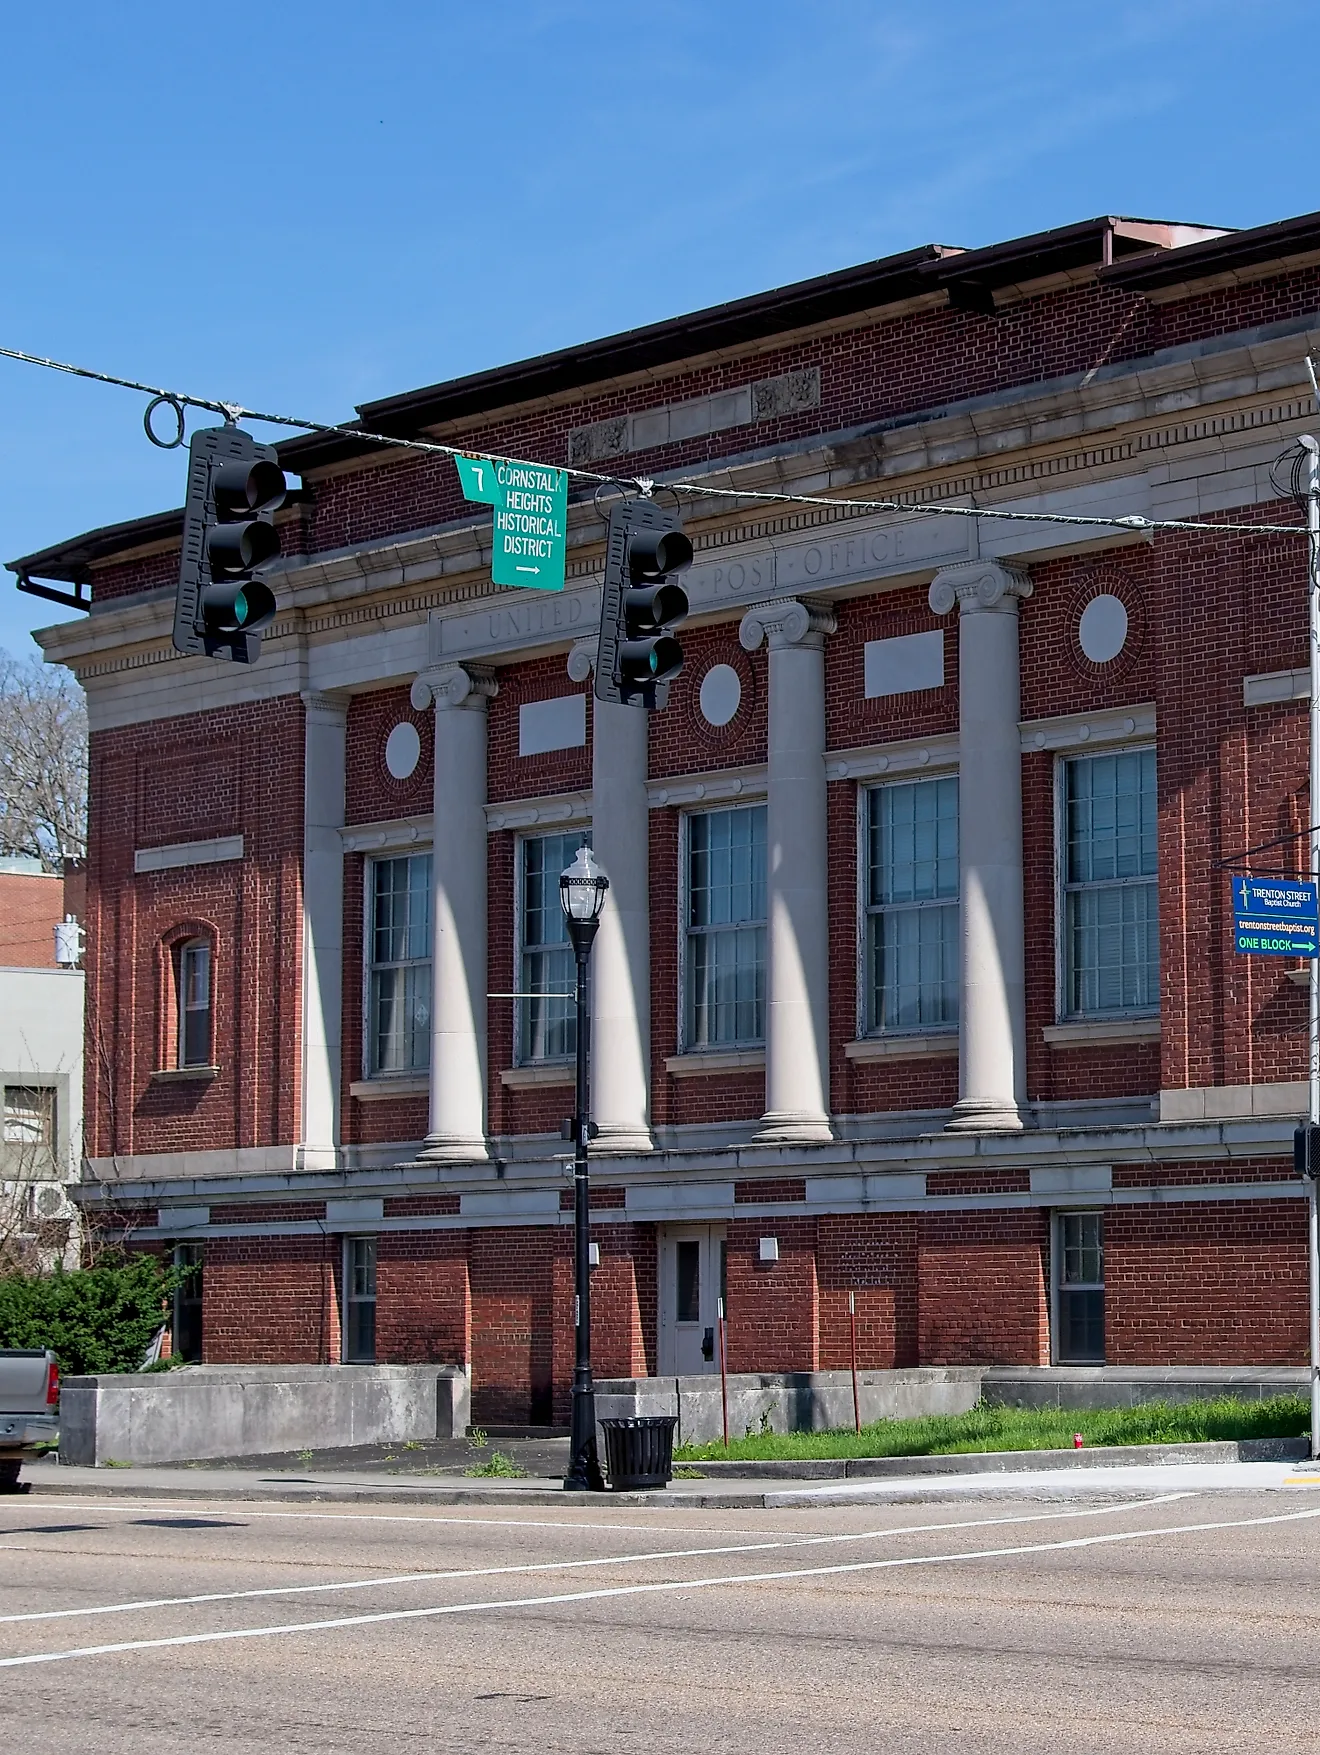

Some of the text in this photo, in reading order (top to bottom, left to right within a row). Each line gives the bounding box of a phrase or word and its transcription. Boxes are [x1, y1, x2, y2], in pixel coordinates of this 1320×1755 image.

[497, 466, 562, 492] CORNSTALK
[506, 490, 552, 514] HEIGHTS
[497, 511, 562, 537] HISTORICAL
[504, 535, 553, 558] DISTRICT
[488, 598, 582, 639] UNITED
[713, 556, 778, 594] POST
[804, 530, 905, 575] OFFICE
[1252, 888, 1312, 902] TRENTON STREET
[1264, 899, 1301, 908] Baptist Church
[1239, 920, 1315, 936] trentonstreetbaptist.org
[1239, 937, 1292, 951] ONE BLOCK
